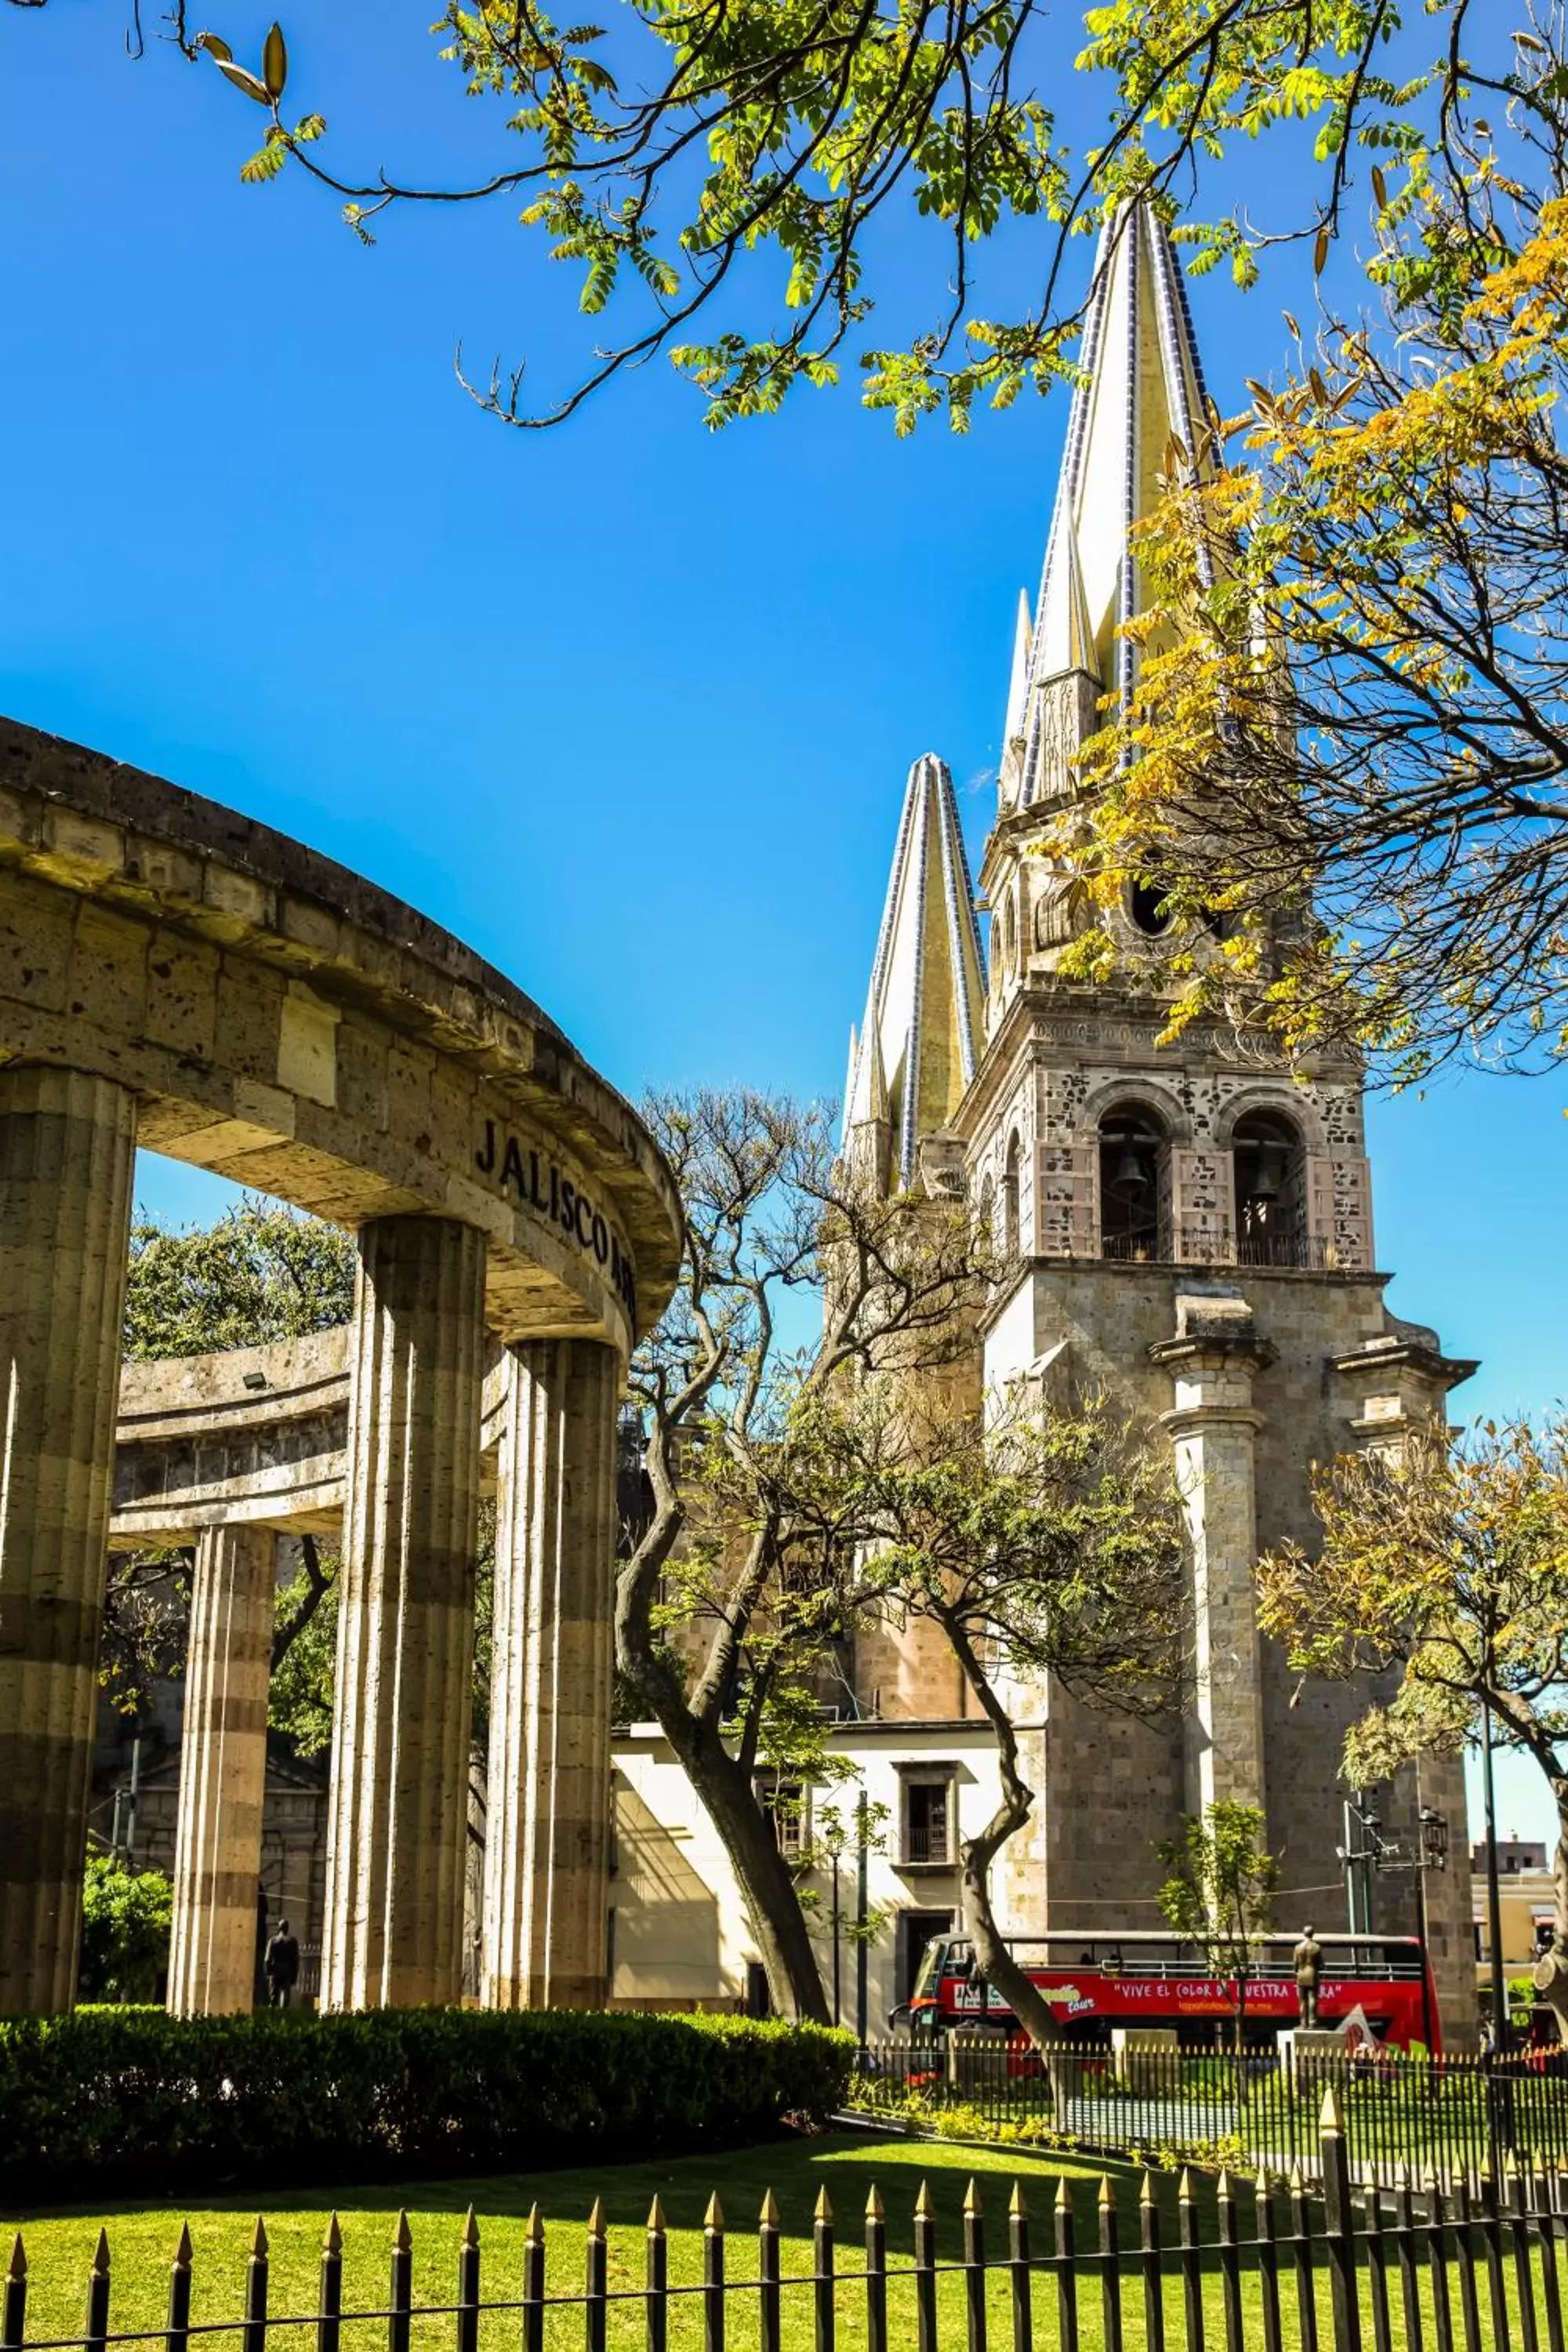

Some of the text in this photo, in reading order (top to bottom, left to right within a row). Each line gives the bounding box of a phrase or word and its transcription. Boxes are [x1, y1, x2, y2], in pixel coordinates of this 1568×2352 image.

[476, 1119, 608, 1265] JALISCO
[1156, 1984, 1171, 1998] EL
[1176, 1983, 1212, 1998] COLOR
